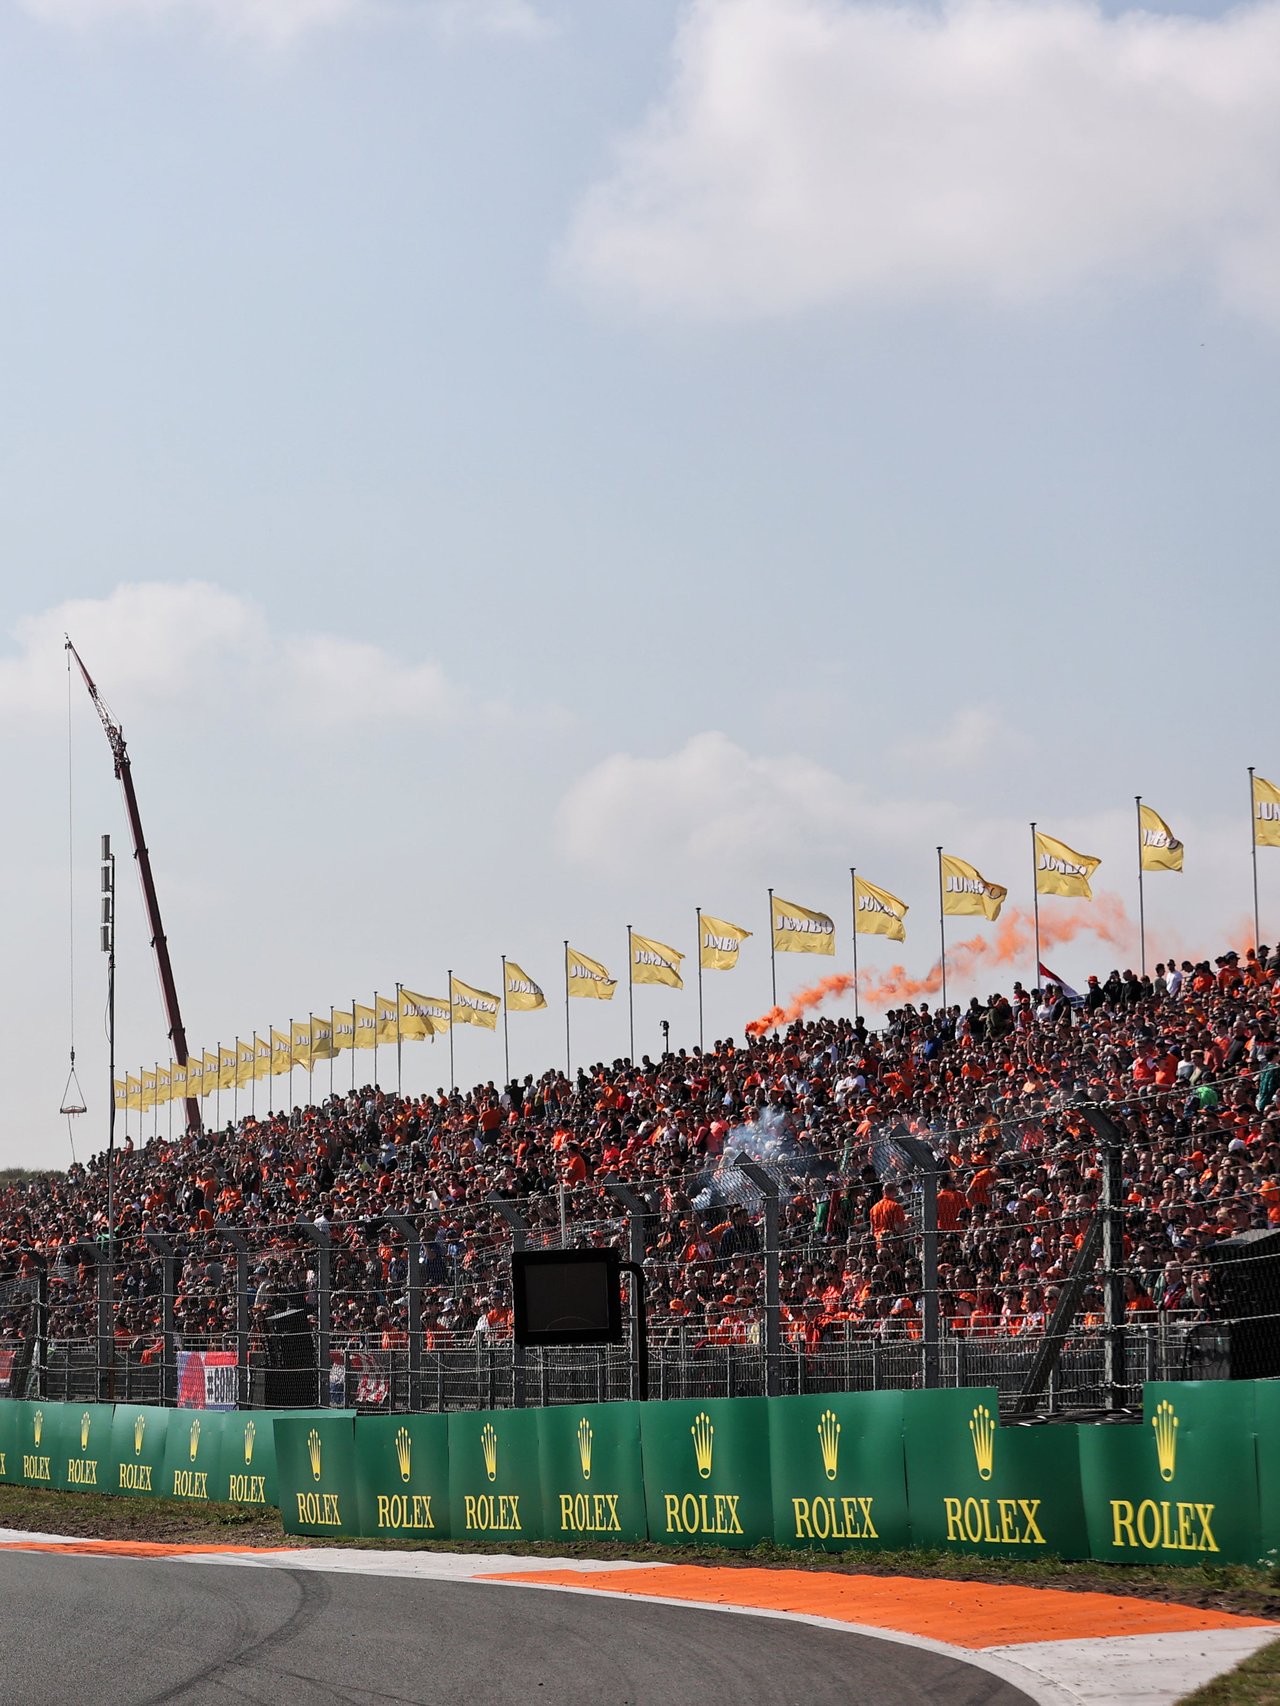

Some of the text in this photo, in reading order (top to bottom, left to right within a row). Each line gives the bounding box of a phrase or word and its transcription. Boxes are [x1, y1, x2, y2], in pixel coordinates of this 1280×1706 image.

[23, 1455, 51, 1481] ROLEX
[68, 1459, 98, 1485] ROLEX
[119, 1465, 152, 1491] ROLEX
[173, 1470, 208, 1500] ROLEX
[228, 1475, 266, 1504] ROLEX
[296, 1492, 342, 1526] ROLEX
[377, 1494, 435, 1529] ROLEX
[464, 1494, 522, 1531] ROLEX
[559, 1493, 621, 1532] ROLEX
[665, 1493, 744, 1535] ROLEX
[792, 1496, 879, 1539] ROLEX
[944, 1496, 1047, 1544] ROLEX
[1110, 1499, 1221, 1553] ROLEX
